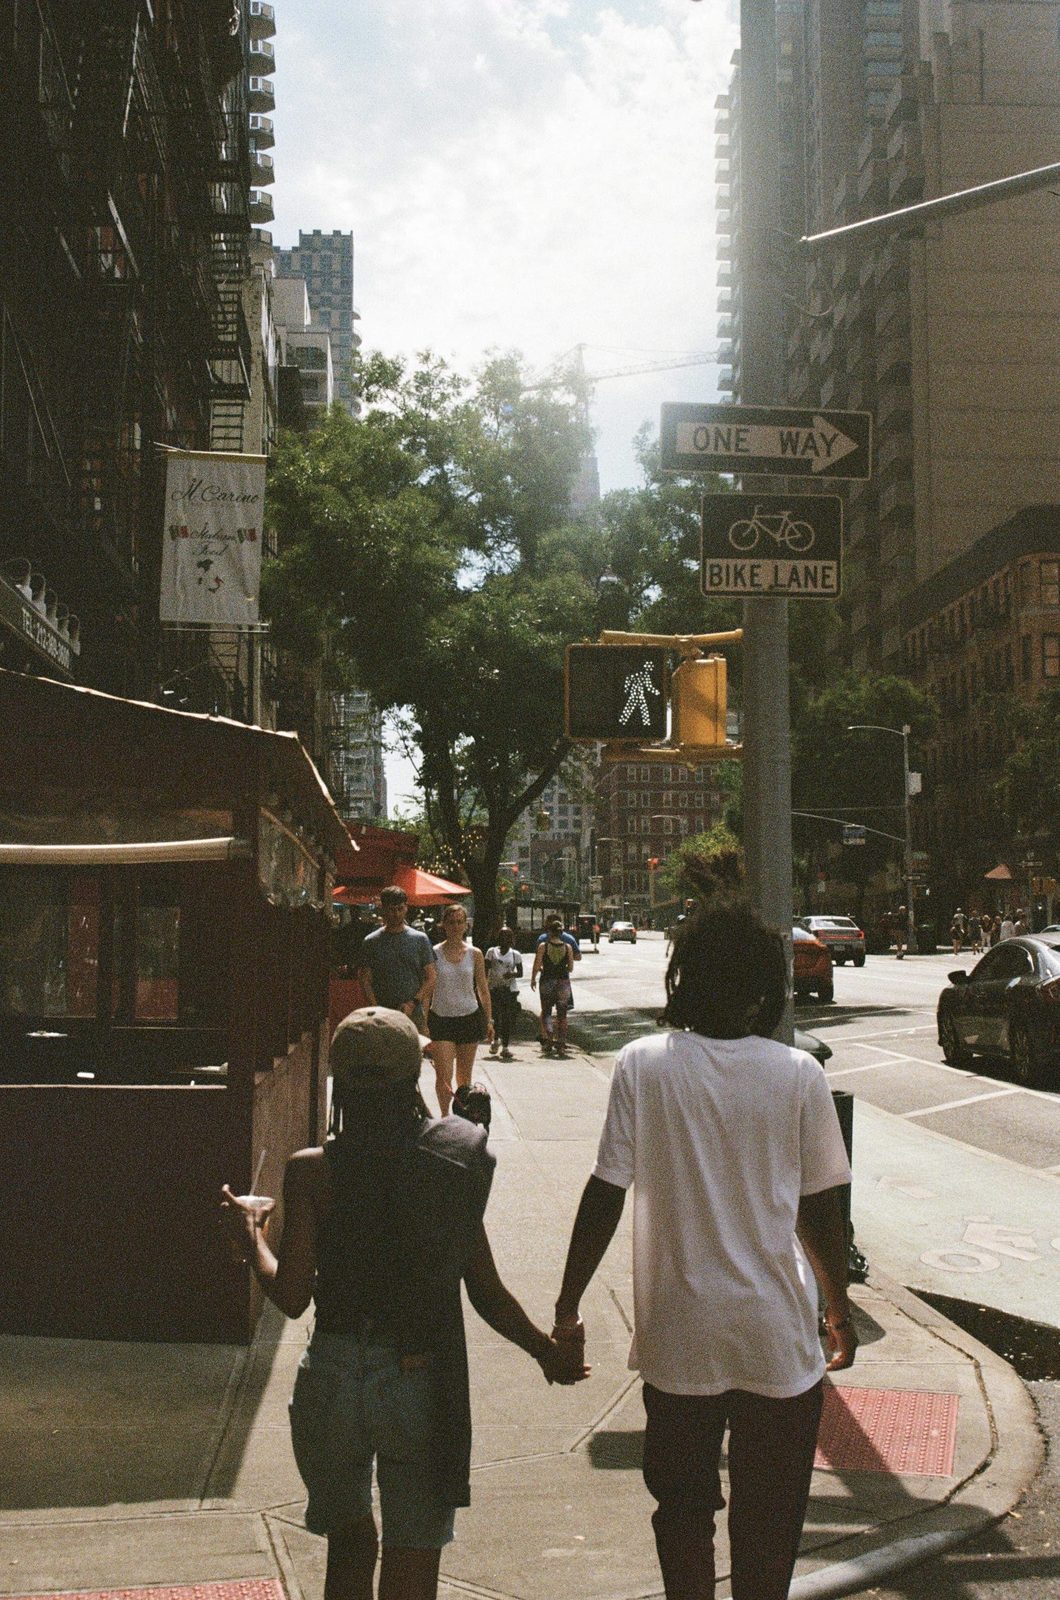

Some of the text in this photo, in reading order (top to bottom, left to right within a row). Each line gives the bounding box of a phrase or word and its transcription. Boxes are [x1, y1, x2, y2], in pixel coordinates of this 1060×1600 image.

[692, 426, 840, 458] ONE WAY
[201, 485, 260, 504] Carino
[709, 564, 834, 589] BIKE LANE
